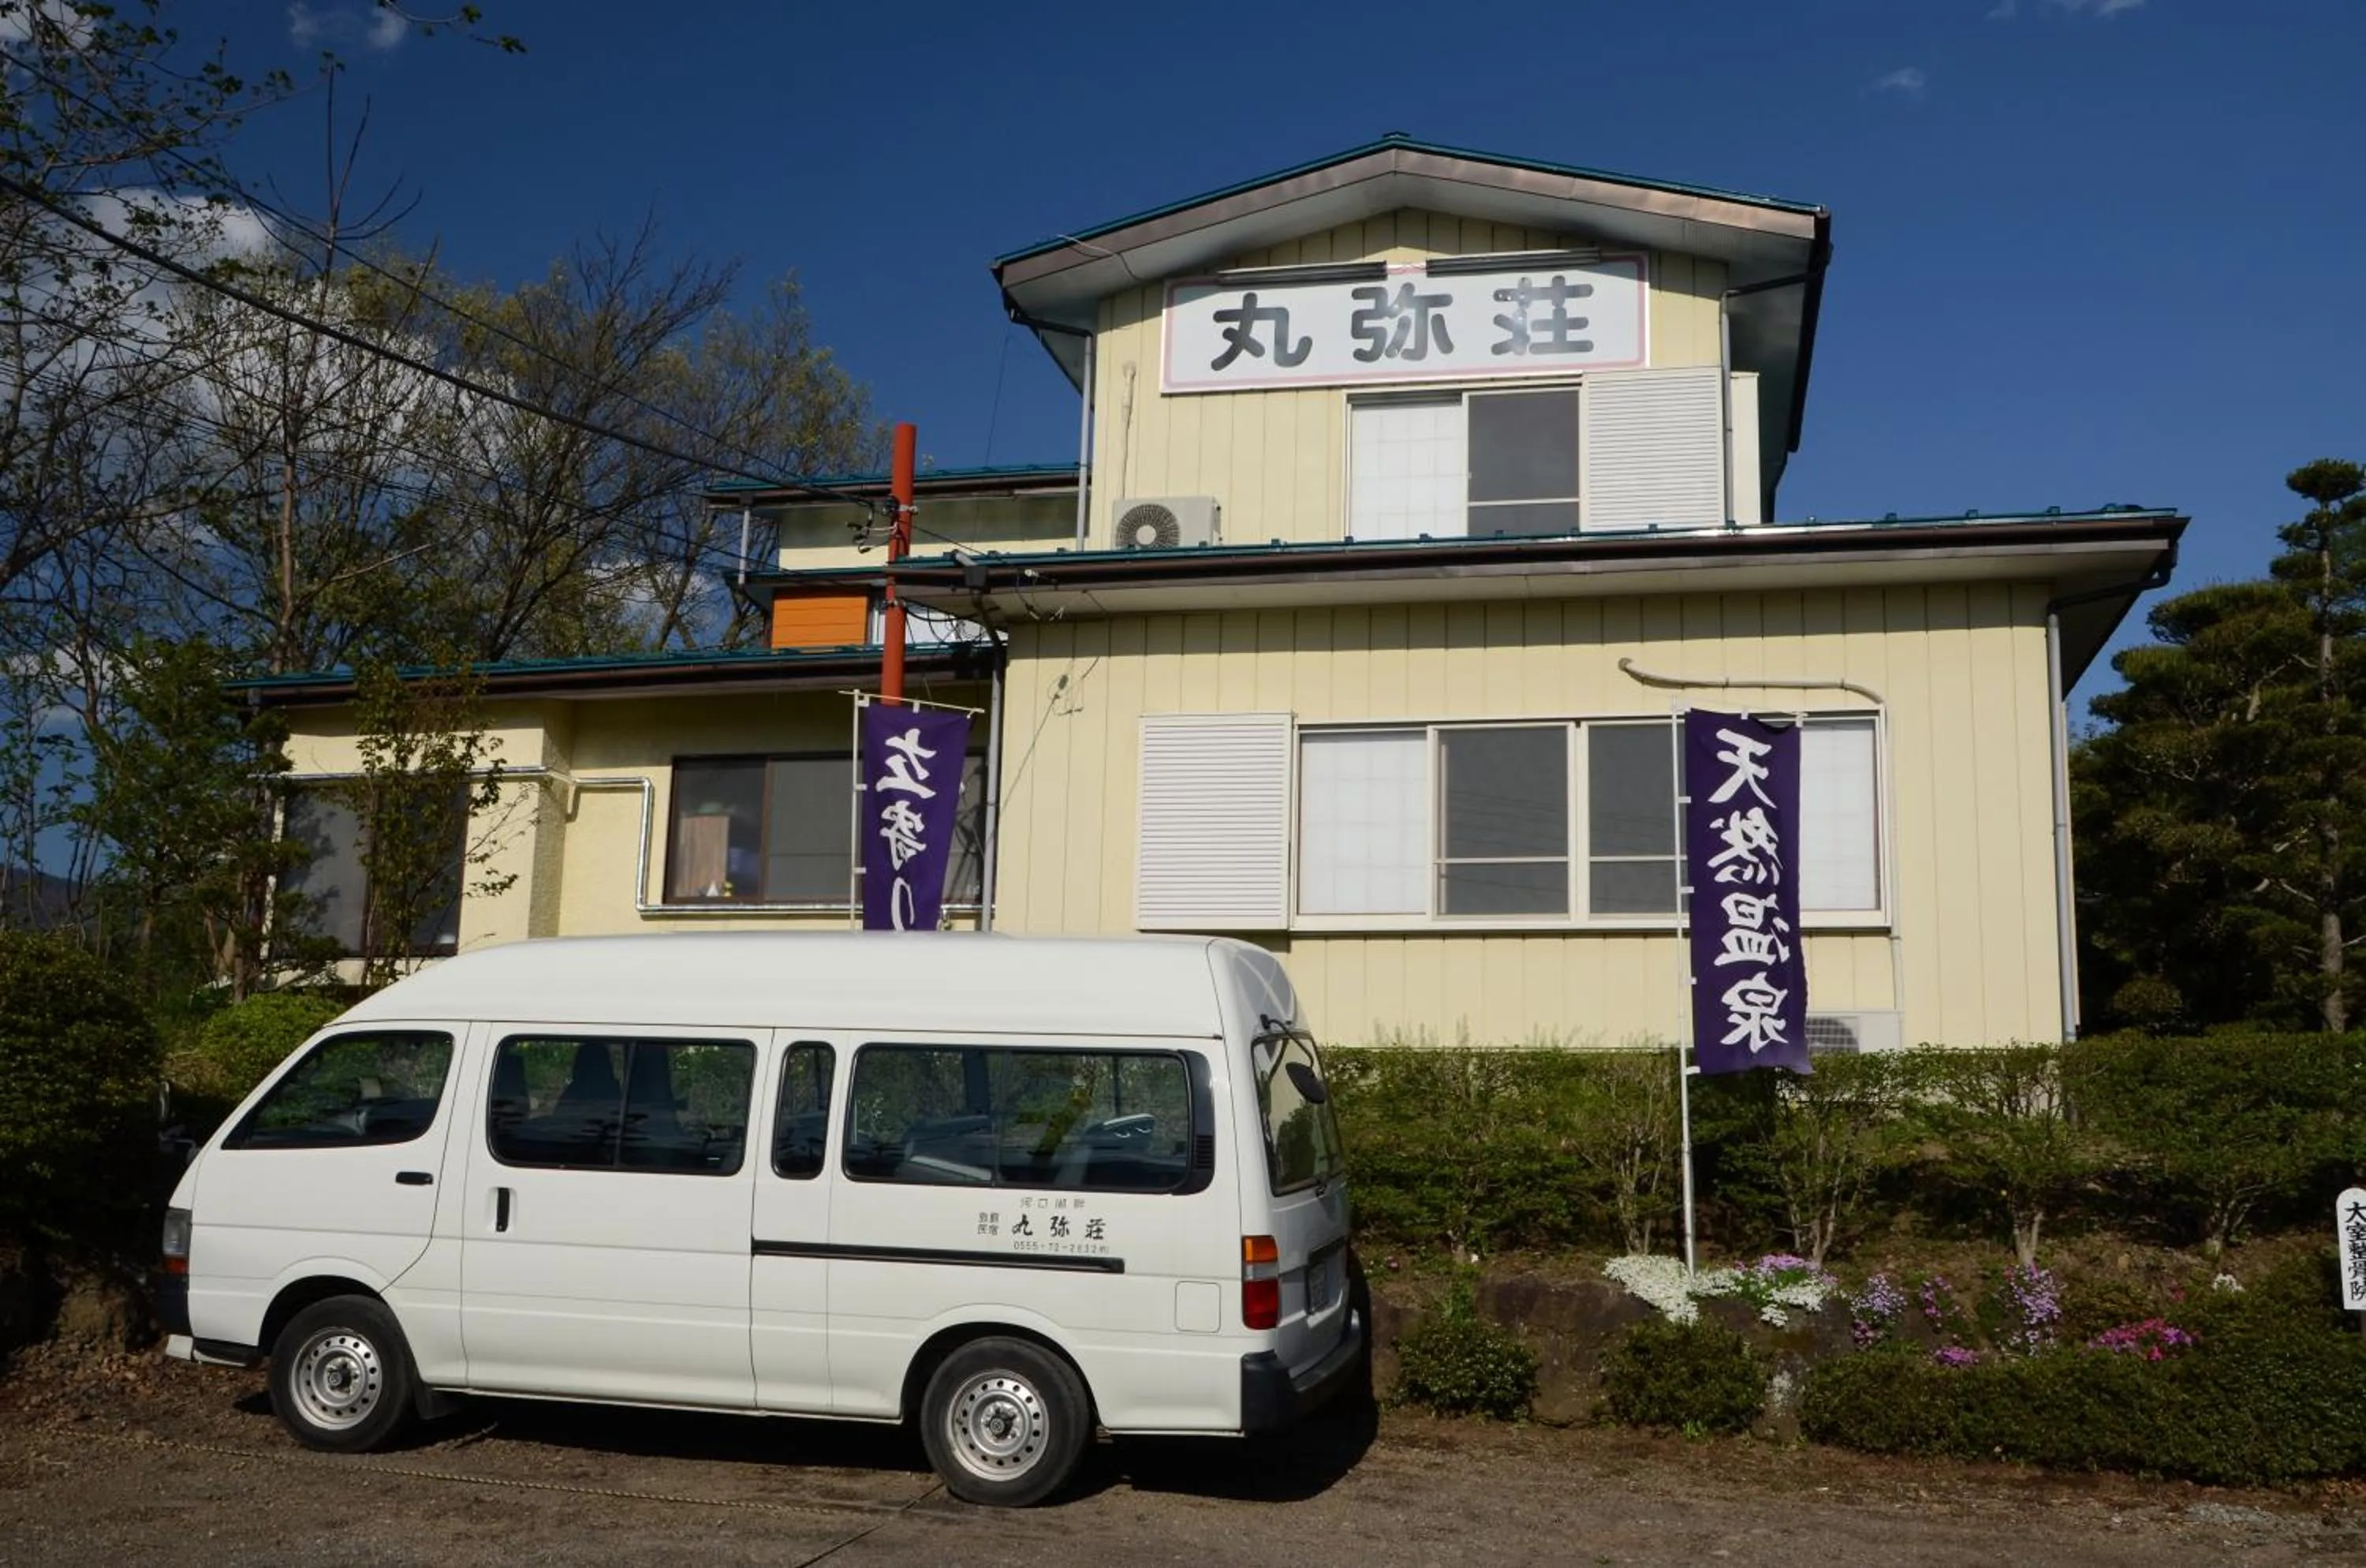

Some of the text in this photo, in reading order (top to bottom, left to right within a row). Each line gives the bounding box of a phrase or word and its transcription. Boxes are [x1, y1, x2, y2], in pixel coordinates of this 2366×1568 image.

[1211, 275, 1594, 371] 丸弥荘
[1011, 1214, 1106, 1240] 丸弥荘
